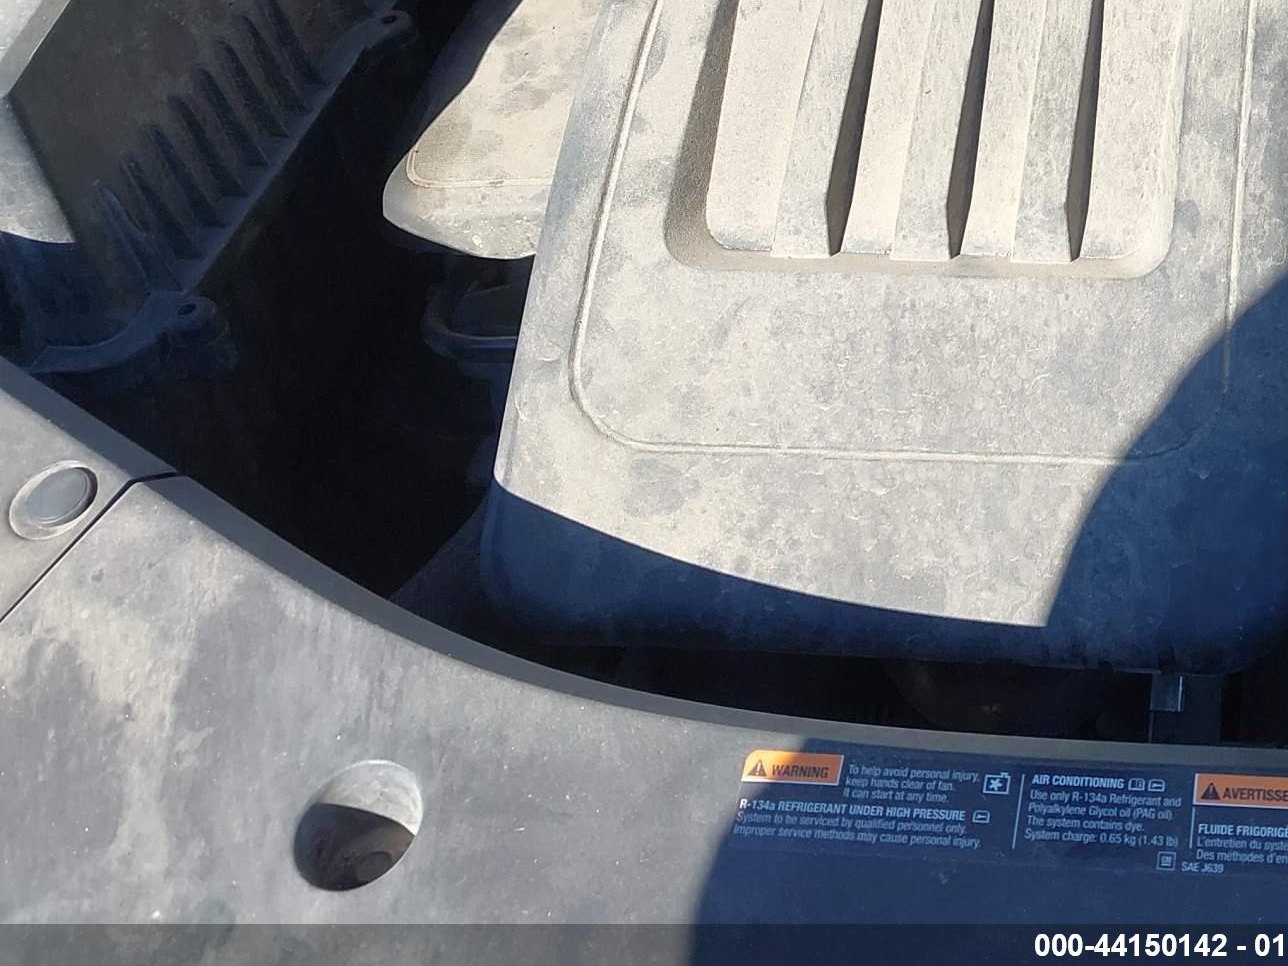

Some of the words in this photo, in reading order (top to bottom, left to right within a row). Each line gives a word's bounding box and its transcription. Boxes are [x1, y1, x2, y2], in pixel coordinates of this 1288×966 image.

[772, 764, 829, 778] WARNING
[849, 764, 859, 774] To
[861, 765, 880, 777] help
[884, 767, 909, 777] avoid
[910, 769, 951, 780] personal
[845, 777, 868, 787] keep
[871, 779, 899, 789] hands
[901, 779, 925, 790] clear
[926, 781, 935, 790] of
[938, 781, 955, 791] fan.
[1032, 775, 1049, 785] AIR
[1052, 775, 1125, 789] CONDITIONING
[852, 790, 869, 799] can
[871, 791, 892, 800] start
[894, 791, 904, 801] at
[906, 793, 925, 804] any
[926, 793, 949, 803] time.
[1030, 789, 1048, 801] Use
[1050, 790, 1070, 803] only
[1072, 791, 1107, 803] R-134a
[1109, 793, 1161, 807] Refrigerant
[1163, 796, 1182, 807] and
[739, 798, 775, 811] R-134a
[778, 801, 848, 814] REFRIGERANT
[849, 804, 883, 816] UNDER
[886, 807, 910, 818] HIGH
[913, 808, 966, 821] PRESSURE
[1029, 802, 1087, 816] Polyalkylene
[1088, 805, 1117, 818] Glycol
[1119, 807, 1131, 817] oil
[1133, 807, 1156, 819] (PAG
[736, 811, 771, 824] System
[774, 813, 783, 823] to
[785, 814, 797, 825] be
[800, 815, 839, 827] serviced
[841, 816, 852, 828] by
[854, 818, 896, 830] qualified
[897, 821, 944, 834] personnel
[1027, 815, 1044, 826] The
[1047, 817, 1081, 830] system
[1083, 819, 1122, 830] contains
[1125, 821, 1145, 832] dye.
[1198, 824, 1234, 835] FLUIDE
[734, 825, 776, 837] Improper
[778, 827, 812, 838] service
[814, 829, 853, 841] methods
[857, 832, 878, 844] may
[880, 834, 908, 843] cause
[910, 834, 951, 846] personal
[953, 837, 981, 849] injury.
[1024, 828, 1060, 841] System
[1062, 831, 1097, 844] charge:
[1100, 833, 1122, 844] 0.65
[1124, 834, 1136, 847] kg
[1138, 835, 1164, 847] (1.43
[1250, 838, 1261, 849] du
[1196, 849, 1215, 860] Des
[1217, 850, 1264, 862] méthodes
[1181, 861, 1200, 872] SAE
[1201, 863, 1224, 874] J639
